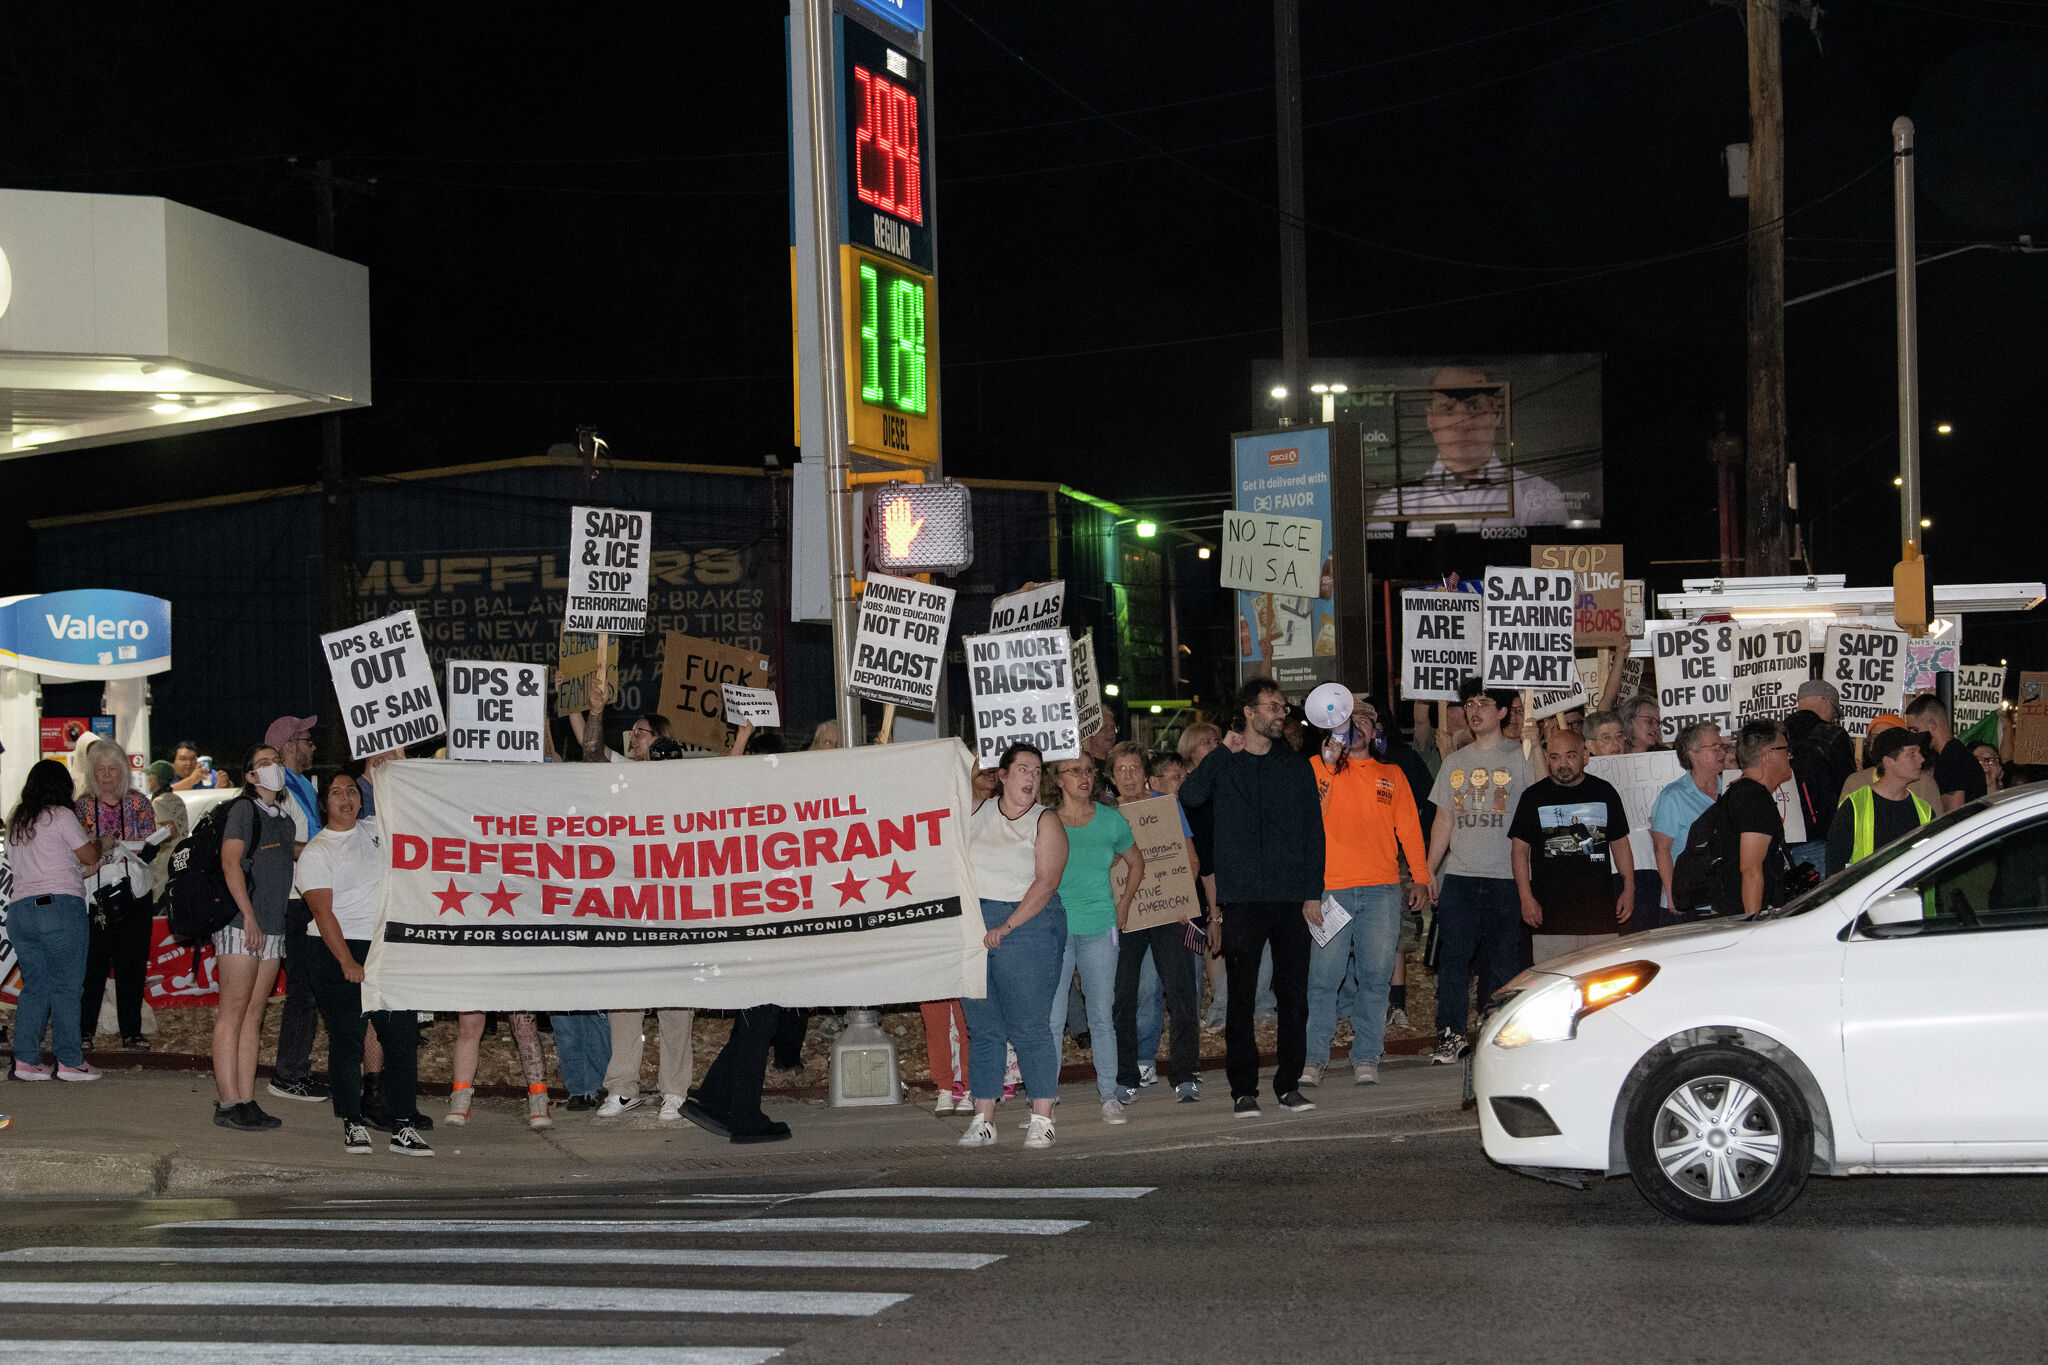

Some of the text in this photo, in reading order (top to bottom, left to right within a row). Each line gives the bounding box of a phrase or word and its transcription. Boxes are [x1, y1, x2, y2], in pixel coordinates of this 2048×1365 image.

[873, 213, 912, 260] REGULAR
[882, 413, 910, 452] DIESEL
[1270, 453, 1288, 462] CIRCLE
[1242, 471, 1327, 491] Get it delivered with
[1274, 492, 1315, 509] FAVOR
[585, 511, 643, 541] SAPD
[1228, 518, 1256, 542] NO
[1481, 527, 1527, 541] 002290
[582, 539, 640, 569] & ICE
[1541, 546, 1607, 573] STOP
[588, 570, 632, 592] STOP
[1229, 555, 1253, 582] IN
[1264, 558, 1304, 589] S.A.
[865, 582, 947, 612] MONEY FOR
[1487, 575, 1572, 602] S.A.P.D
[474, 596, 566, 616] BALAN
[668, 588, 764, 611] BRAKES
[571, 595, 647, 613] TERRORIZING
[862, 600, 946, 625] JOBS AND EDUCATION
[991, 595, 1060, 630] NO A LAS
[1405, 598, 1480, 612] IMMIGRANTS
[45, 614, 149, 641] Valero
[421, 620, 465, 641] NGE
[478, 619, 538, 640] NEW
[649, 613, 688, 634] SED
[694, 611, 764, 633] TIRES
[568, 614, 647, 631] SAN ANTONIO
[1416, 615, 1465, 640] ARE
[1487, 605, 1572, 627] TEARING
[1574, 608, 1623, 633] HBORS
[328, 620, 415, 661] DPS & ICE
[863, 613, 940, 646] NOT FOR
[1657, 626, 1732, 658] DPS &
[972, 641, 1000, 662] NO
[1005, 636, 1063, 660] MORE
[1488, 632, 1573, 653] FAMILIES
[1738, 629, 1802, 662] NO TO
[1838, 633, 1899, 657] SAPD
[350, 646, 407, 689] OUT
[857, 643, 938, 681] RACIST
[1072, 643, 1087, 669] PD
[1411, 649, 1478, 665] WELCOME
[1488, 655, 1573, 682] APART
[1682, 656, 1716, 680] ICE
[1733, 655, 1808, 679] DEPORTATIONS
[453, 666, 509, 696] DPS
[516, 668, 540, 697] &
[686, 654, 753, 688] FUCK
[973, 658, 1067, 696] RACIST
[1073, 663, 1090, 690] CE
[1835, 657, 1894, 682] & ICE
[853, 669, 934, 697] DEPORTATIONS
[1542, 682, 1582, 706] ANTOO
[1661, 683, 1731, 707] OFF OU
[1751, 681, 1783, 698] KEEP
[1840, 682, 1885, 702] STOP
[350, 685, 433, 728] OF SAN
[1077, 688, 1088, 709] OP
[1739, 692, 1798, 715] FAMILIES
[1956, 688, 2000, 704] EARING
[477, 698, 514, 723] ICE
[978, 702, 1073, 729] DPS & ICE
[1078, 703, 1100, 724] RIZING
[1662, 711, 1731, 735] STRT
[1840, 704, 1900, 719] RRORIZING
[355, 713, 439, 757] ANTONIO
[452, 728, 540, 751] OFF OUR
[473, 794, 867, 837] THE PEOPLE UNITED WILL
[1138, 814, 1159, 827] are
[392, 808, 950, 880] DEFEND IMMIGRANT
[1141, 840, 1183, 858] migrants
[1171, 865, 1188, 875] are
[541, 874, 814, 921] FAMILIES!
[1136, 885, 1162, 900] TIVE
[1137, 894, 1190, 917] AMERICAN
[404, 903, 945, 942] PARTY FOR SOCIALISM AND LIBERATION SAN ANTONIO @PSLSATX
